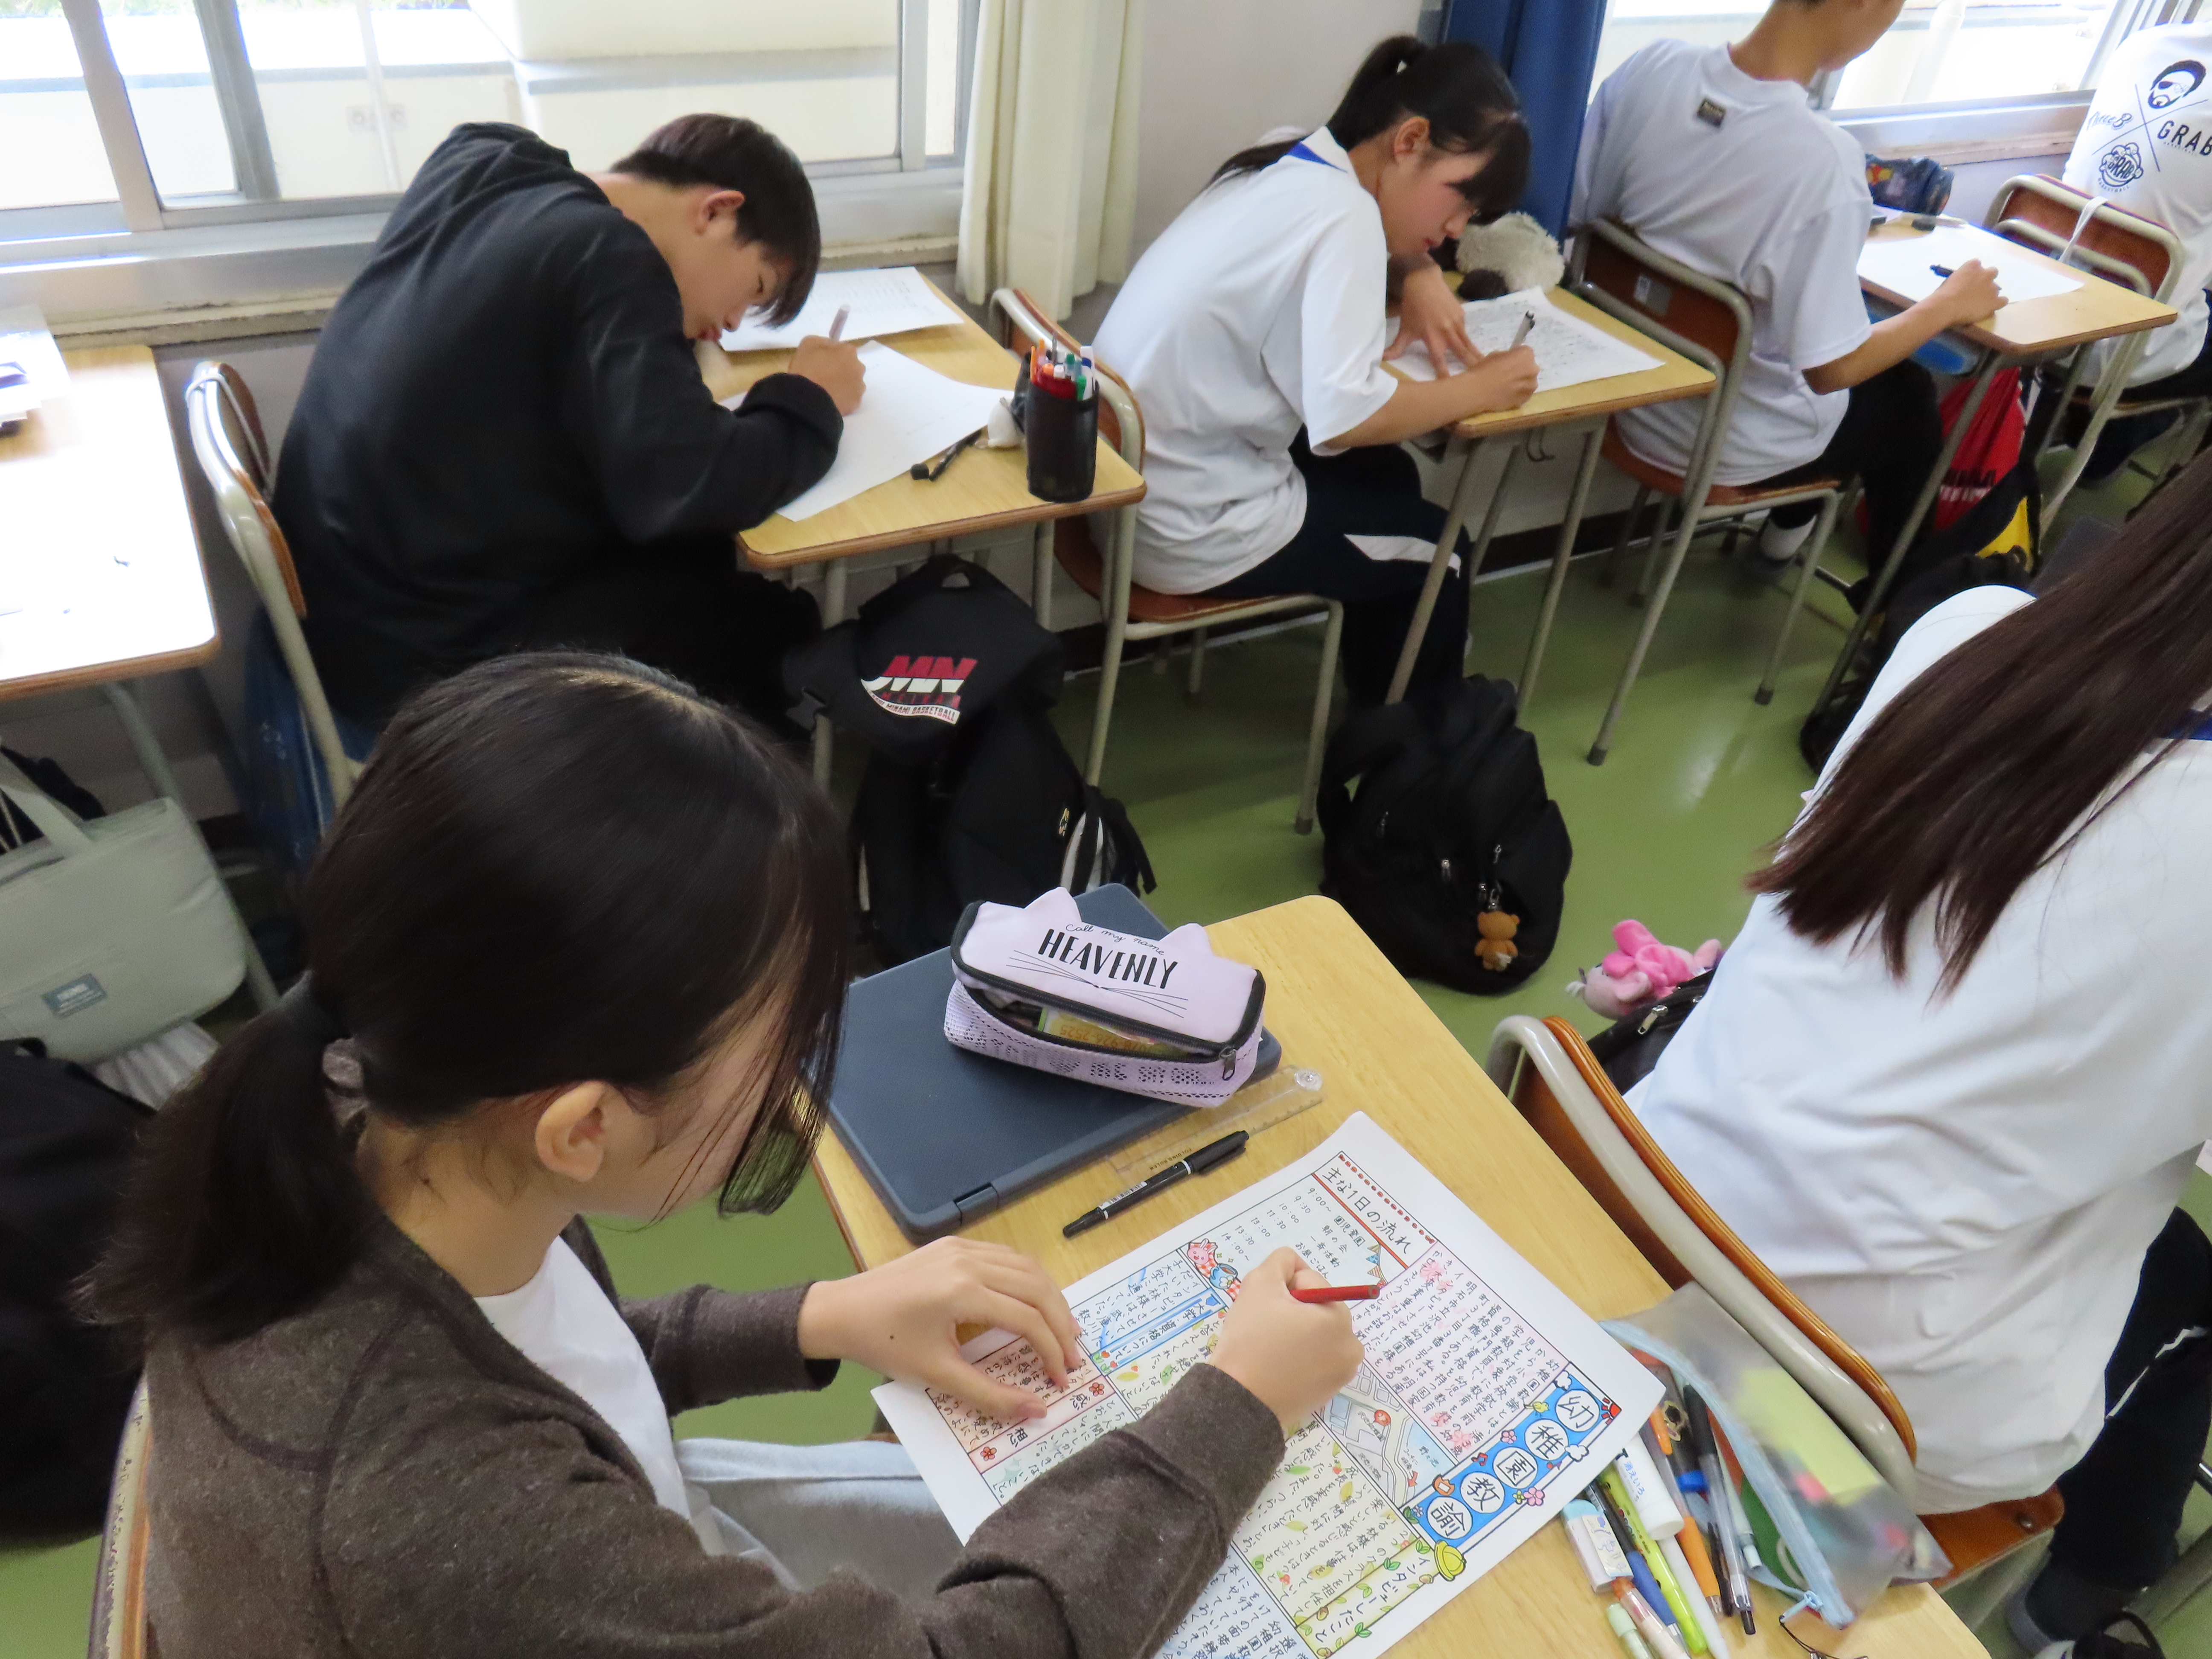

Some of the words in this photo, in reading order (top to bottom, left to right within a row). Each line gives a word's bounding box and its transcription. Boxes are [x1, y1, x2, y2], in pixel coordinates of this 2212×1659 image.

[2157, 120, 2212, 156] GRAB
[1037, 928, 1178, 989] HEAVENLY
[1065, 924, 1094, 932] Call
[1101, 930, 1126, 943] my
[1133, 937, 1164, 955] name
[1267, 1210, 1286, 1229] 11:30
[1279, 1203, 1299, 1223] 10:00
[1294, 1196, 1310, 1213] 9:30
[1322, 1167, 1411, 1254] 主な1日の流れ
[1235, 1225, 1254, 1245] 13:30
[1251, 1217, 1270, 1237] 13:00
[1076, 1260, 1183, 1324] 子大学に通っていた。教
[1091, 1282, 1200, 1347] インタビューさせていた
[1151, 1319, 1225, 1369] と答えてくれた。
[1428, 1391, 1599, 1542] 幼稚園教諭
[1315, 1553, 1430, 1643] インタビューしたこと
